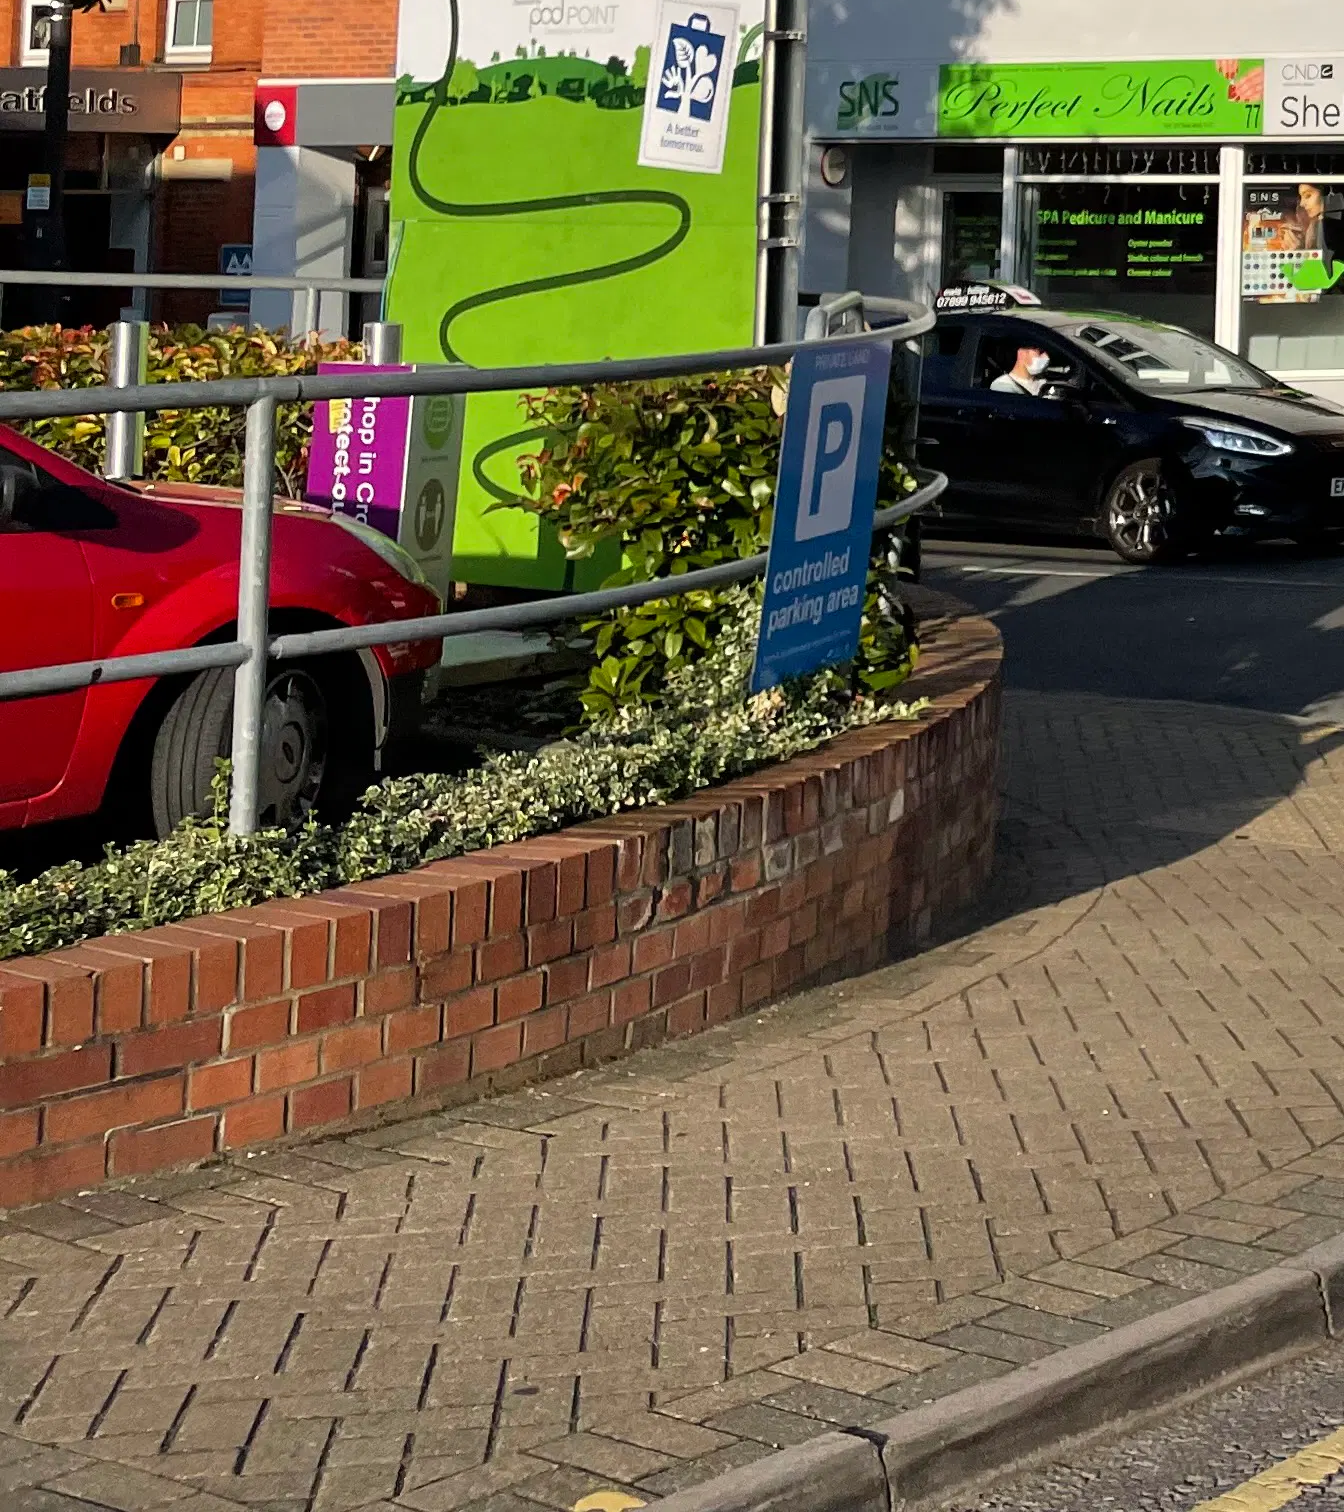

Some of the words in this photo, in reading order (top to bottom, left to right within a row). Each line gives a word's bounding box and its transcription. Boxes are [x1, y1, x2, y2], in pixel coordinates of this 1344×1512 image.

[567, 5, 620, 25] POINT
[838, 81, 899, 117] SNS
[943, 79, 1082, 132] Perfect
[1093, 75, 1216, 119] Nails
[1245, 104, 1261, 128] 77
[666, 122, 673, 134] A
[675, 123, 700, 137] better
[1036, 210, 1059, 225] SPA
[1062, 209, 1115, 225] Pedicure
[1118, 210, 1142, 225] and
[1144, 208, 1203, 225] Manicure
[357, 397, 381, 445] hop
[358, 452, 376, 474] in
[808, 402, 853, 517] P
[773, 546, 851, 595] controlled
[767, 593, 823, 640] parking
[827, 584, 859, 613] area
